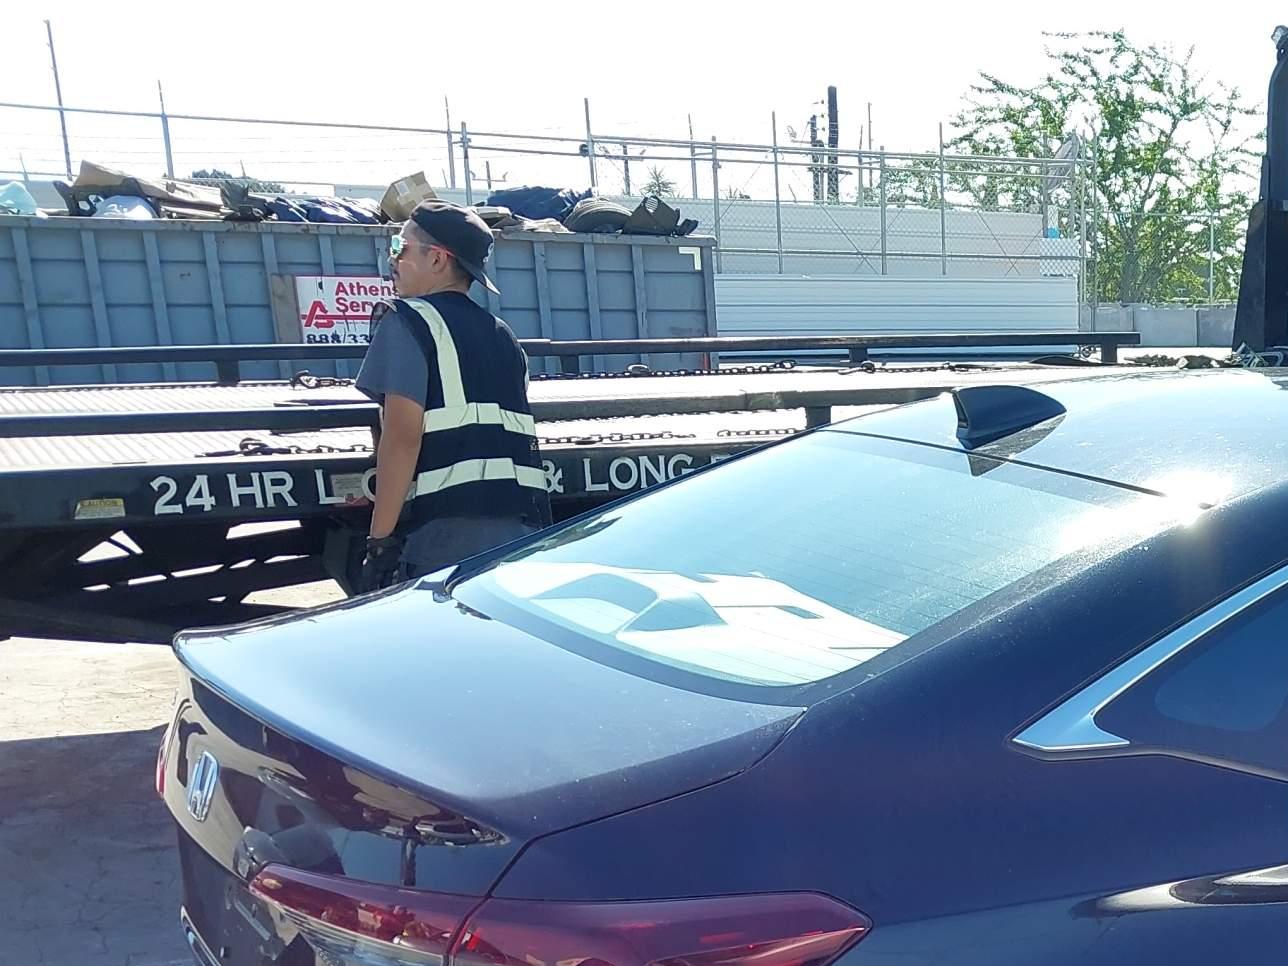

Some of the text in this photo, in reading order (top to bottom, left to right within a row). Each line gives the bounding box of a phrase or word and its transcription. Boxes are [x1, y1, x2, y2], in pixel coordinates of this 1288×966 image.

[150, 474, 216, 515] 24
[226, 471, 298, 509] HR
[542, 459, 564, 493] &
[582, 453, 697, 492] LONG
